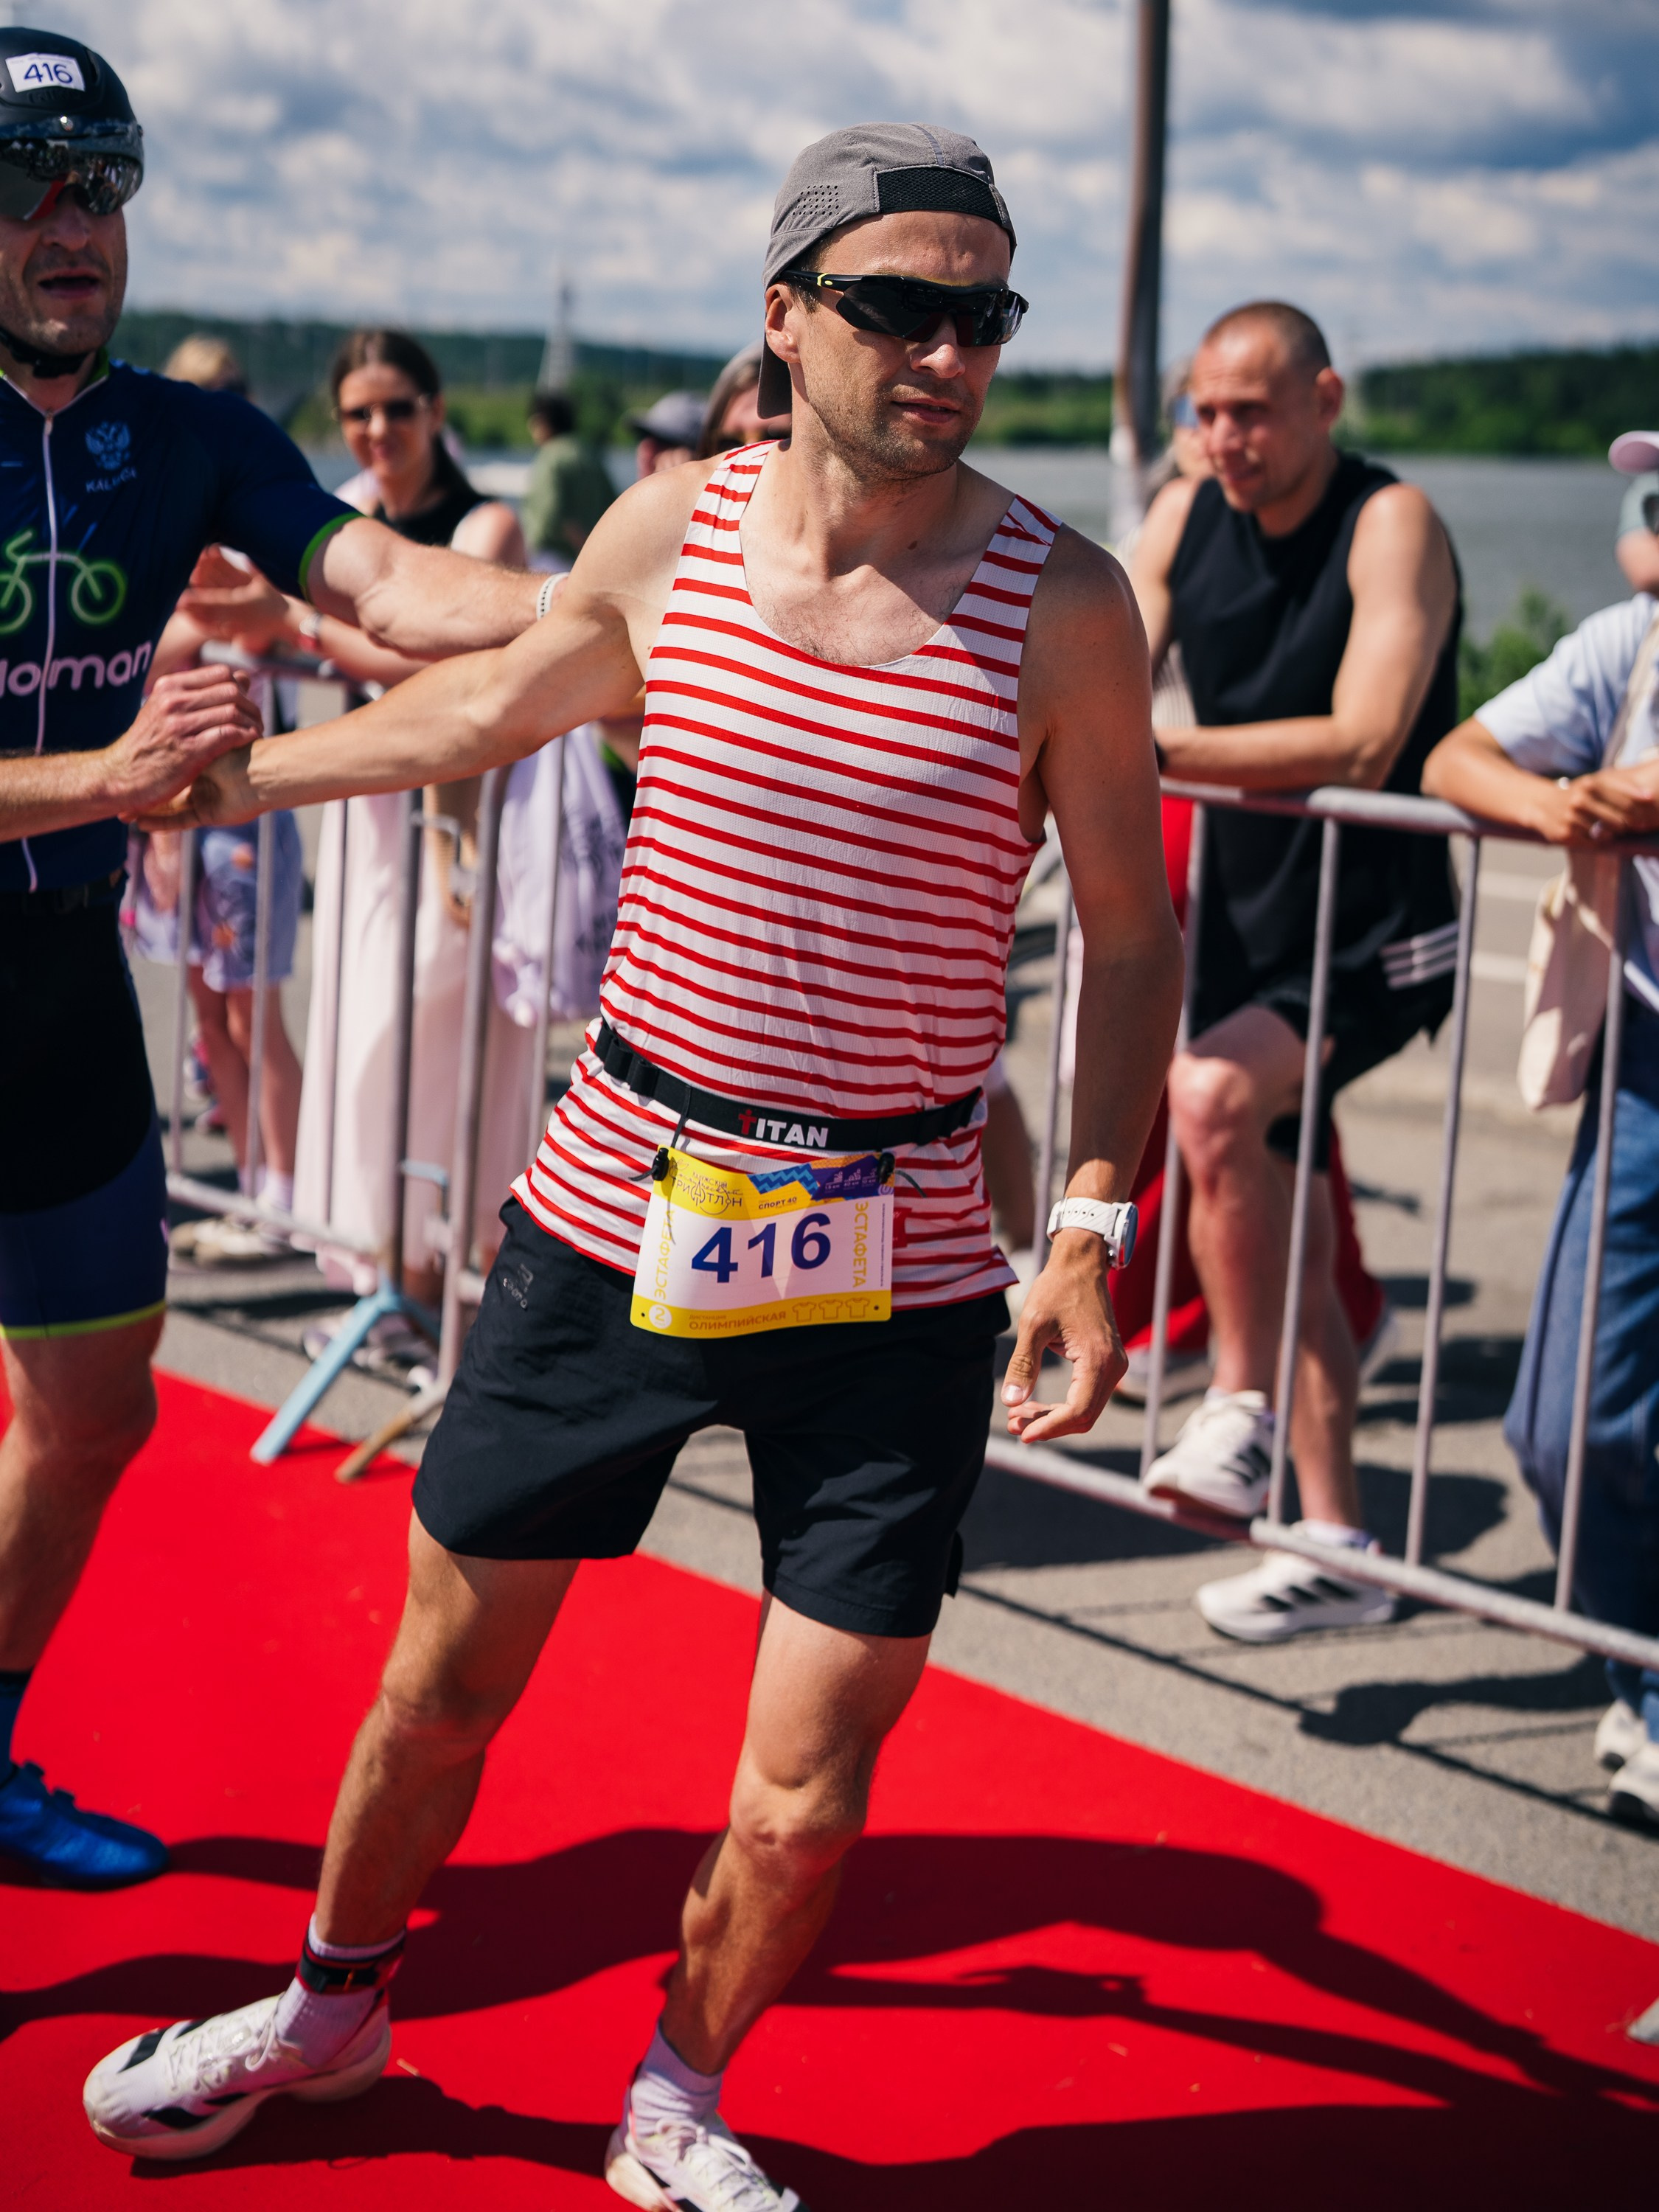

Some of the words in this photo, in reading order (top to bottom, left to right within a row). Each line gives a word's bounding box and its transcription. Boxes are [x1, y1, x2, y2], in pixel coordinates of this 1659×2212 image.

[24, 63, 73, 83] 416
[738, 1109, 829, 1148] TITAN
[759, 1199, 786, 1209] СПОРТ
[787, 1196, 798, 1204] 40
[654, 1209, 675, 1300] ЭСТАФЕТА
[692, 1212, 832, 1284] 416
[852, 1201, 869, 1288] ЭСТАФЕТА
[655, 1307, 666, 1323] 2
[689, 1310, 787, 1331] ОЛИМПИЙСКАЯ
